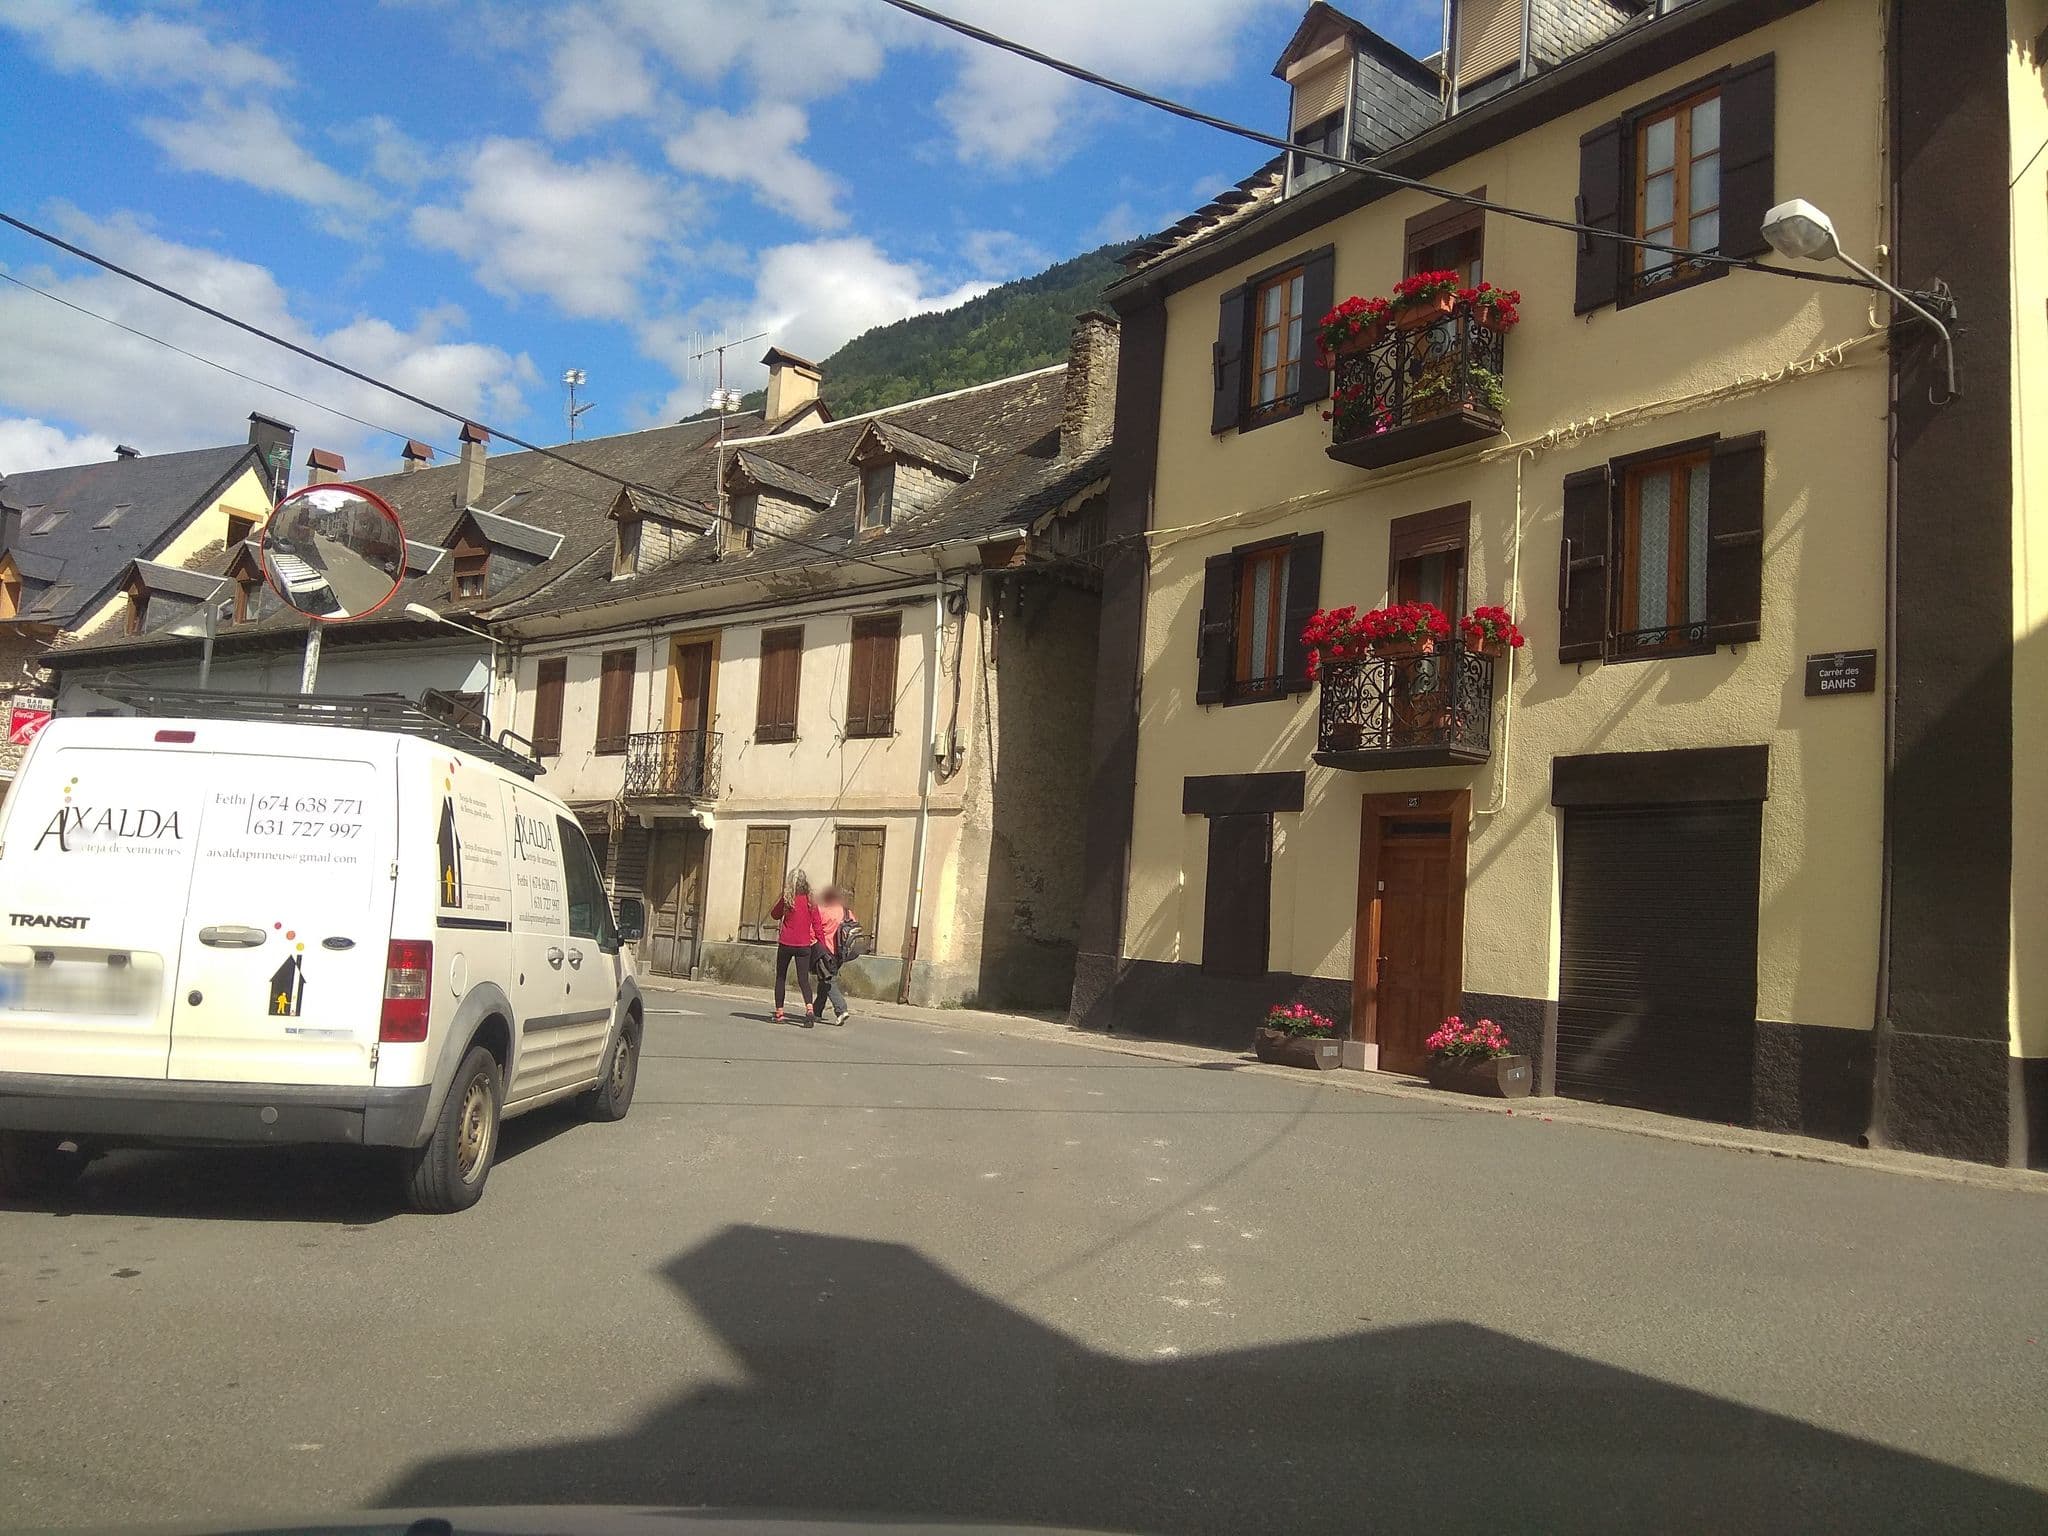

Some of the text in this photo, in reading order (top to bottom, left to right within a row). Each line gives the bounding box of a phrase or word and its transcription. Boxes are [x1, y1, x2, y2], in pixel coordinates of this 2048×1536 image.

[1845, 667, 1859, 675] des
[1821, 678, 1856, 690] BANHS
[258, 795, 289, 811] 674
[295, 797, 327, 813] 638
[333, 799, 363, 815] 771
[254, 820, 363, 840] 631 727 997
[9, 913, 90, 929] TRANSIT
